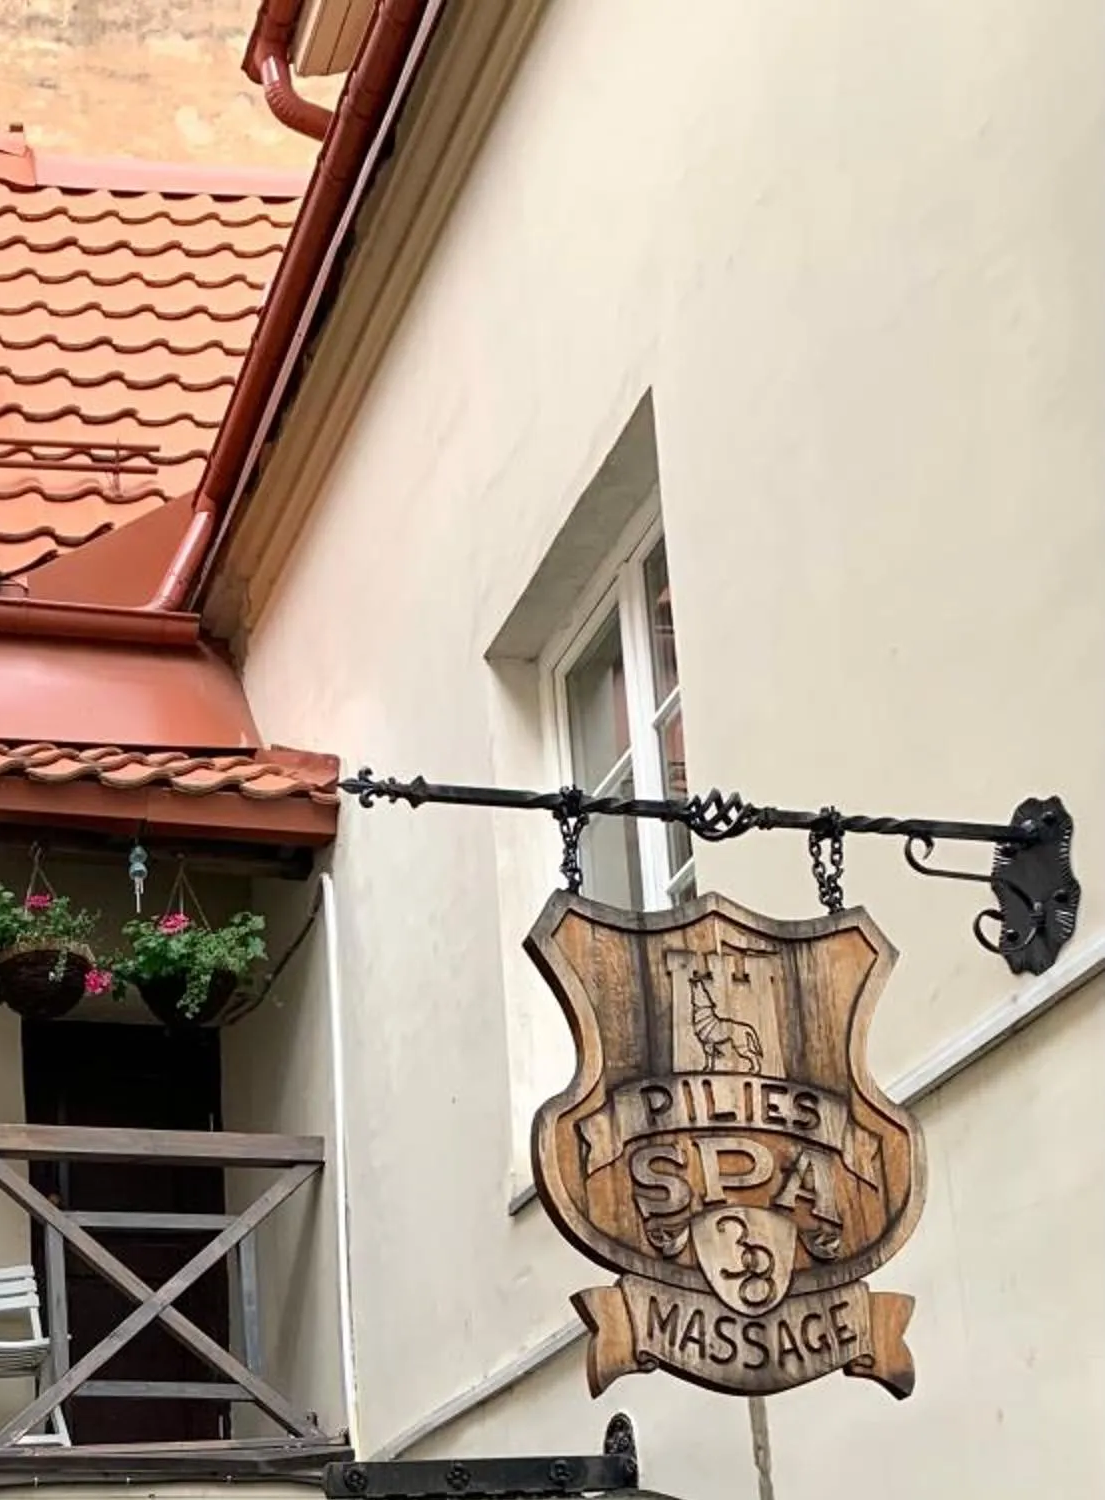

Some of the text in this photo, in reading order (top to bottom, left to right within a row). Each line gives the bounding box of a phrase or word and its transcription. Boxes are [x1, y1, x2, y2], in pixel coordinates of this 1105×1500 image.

[640, 1080, 822, 1131] PILIES
[630, 1136, 843, 1229] SPA
[715, 1215, 777, 1306] 38
[646, 1294, 858, 1370] MASSAGE
